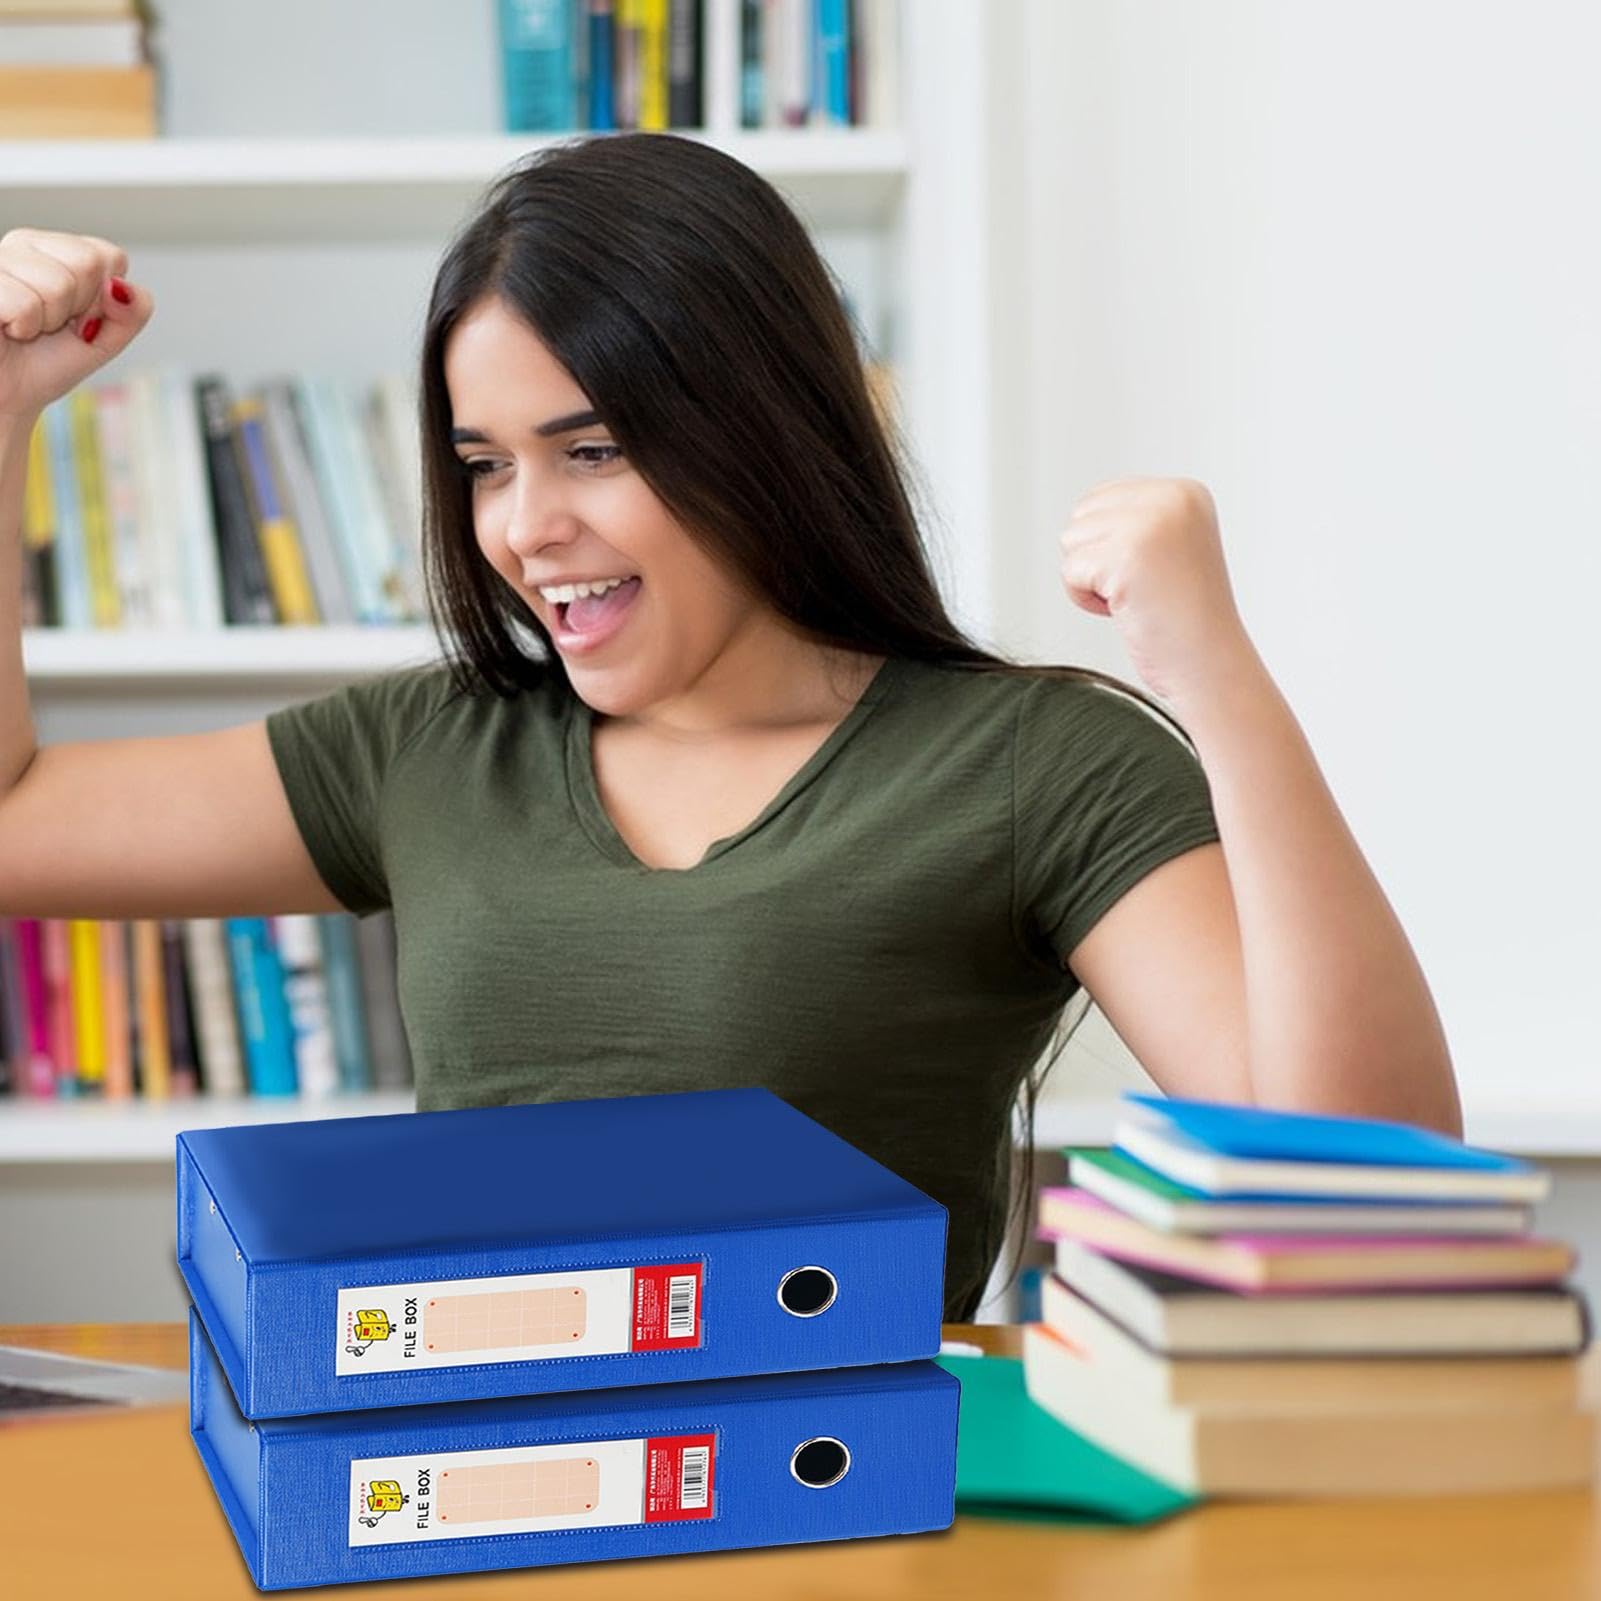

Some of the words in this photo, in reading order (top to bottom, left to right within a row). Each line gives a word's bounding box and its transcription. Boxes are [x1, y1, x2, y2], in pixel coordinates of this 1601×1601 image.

[404, 1297, 418, 1325] BOX
[404, 1331, 417, 1358] FILE
[417, 1468, 431, 1496] BOX
[417, 1502, 430, 1529] FILE
